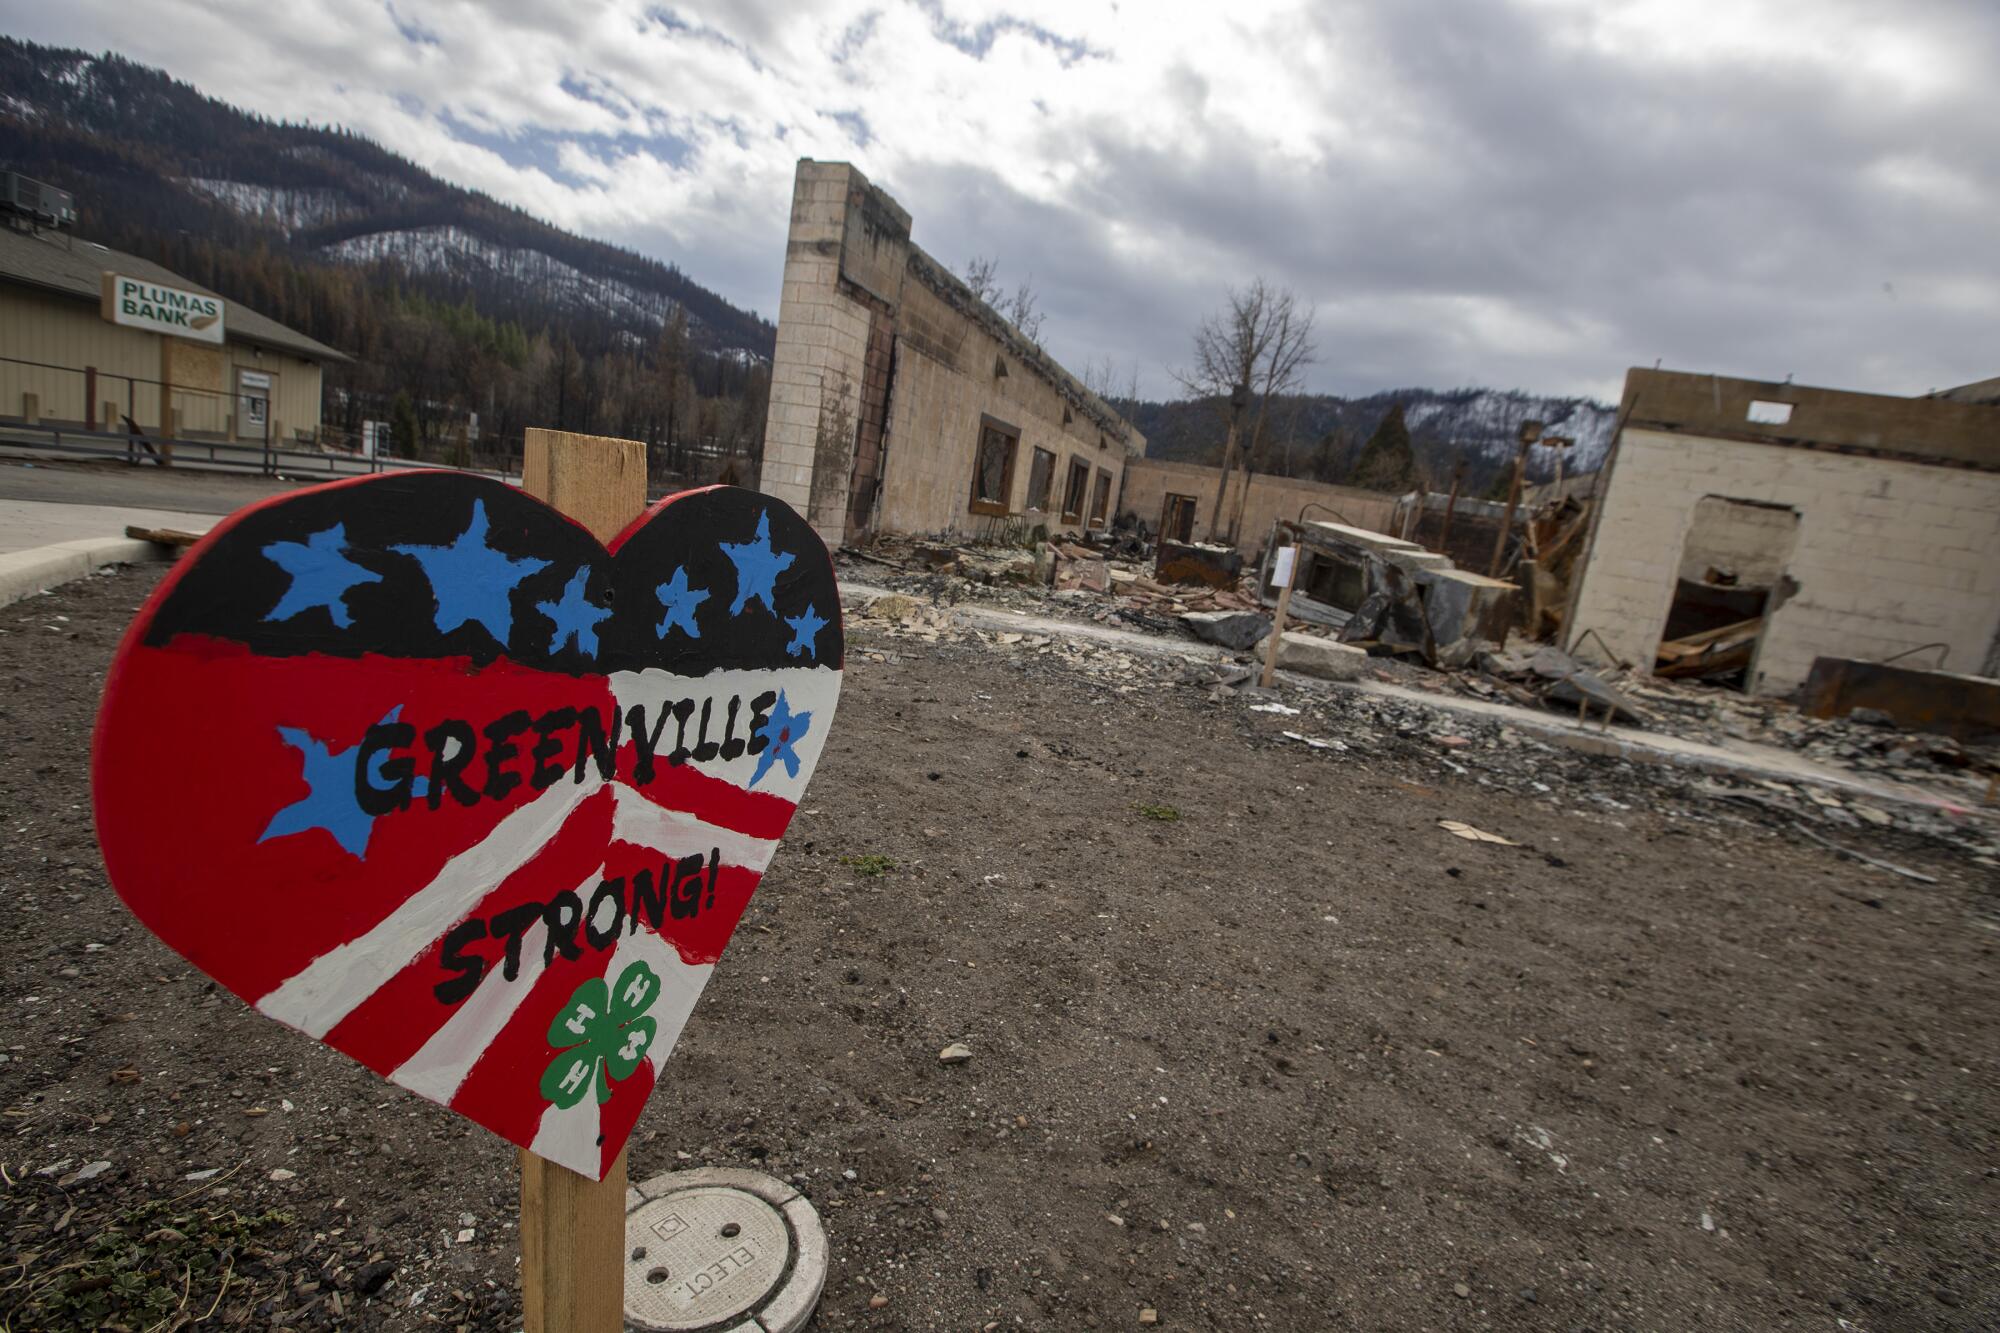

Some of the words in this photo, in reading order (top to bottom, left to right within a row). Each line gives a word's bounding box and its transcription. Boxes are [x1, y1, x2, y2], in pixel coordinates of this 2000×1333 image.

[122, 281, 217, 316] PLUMAS
[122, 299, 188, 327] BANK
[355, 691, 777, 816] GREENVILLE
[433, 847, 721, 1005] STRONG!
[623, 973, 651, 1007] H
[565, 1003, 596, 1034] H
[558, 1059, 590, 1095] H
[685, 1246, 755, 1299] ELECT
